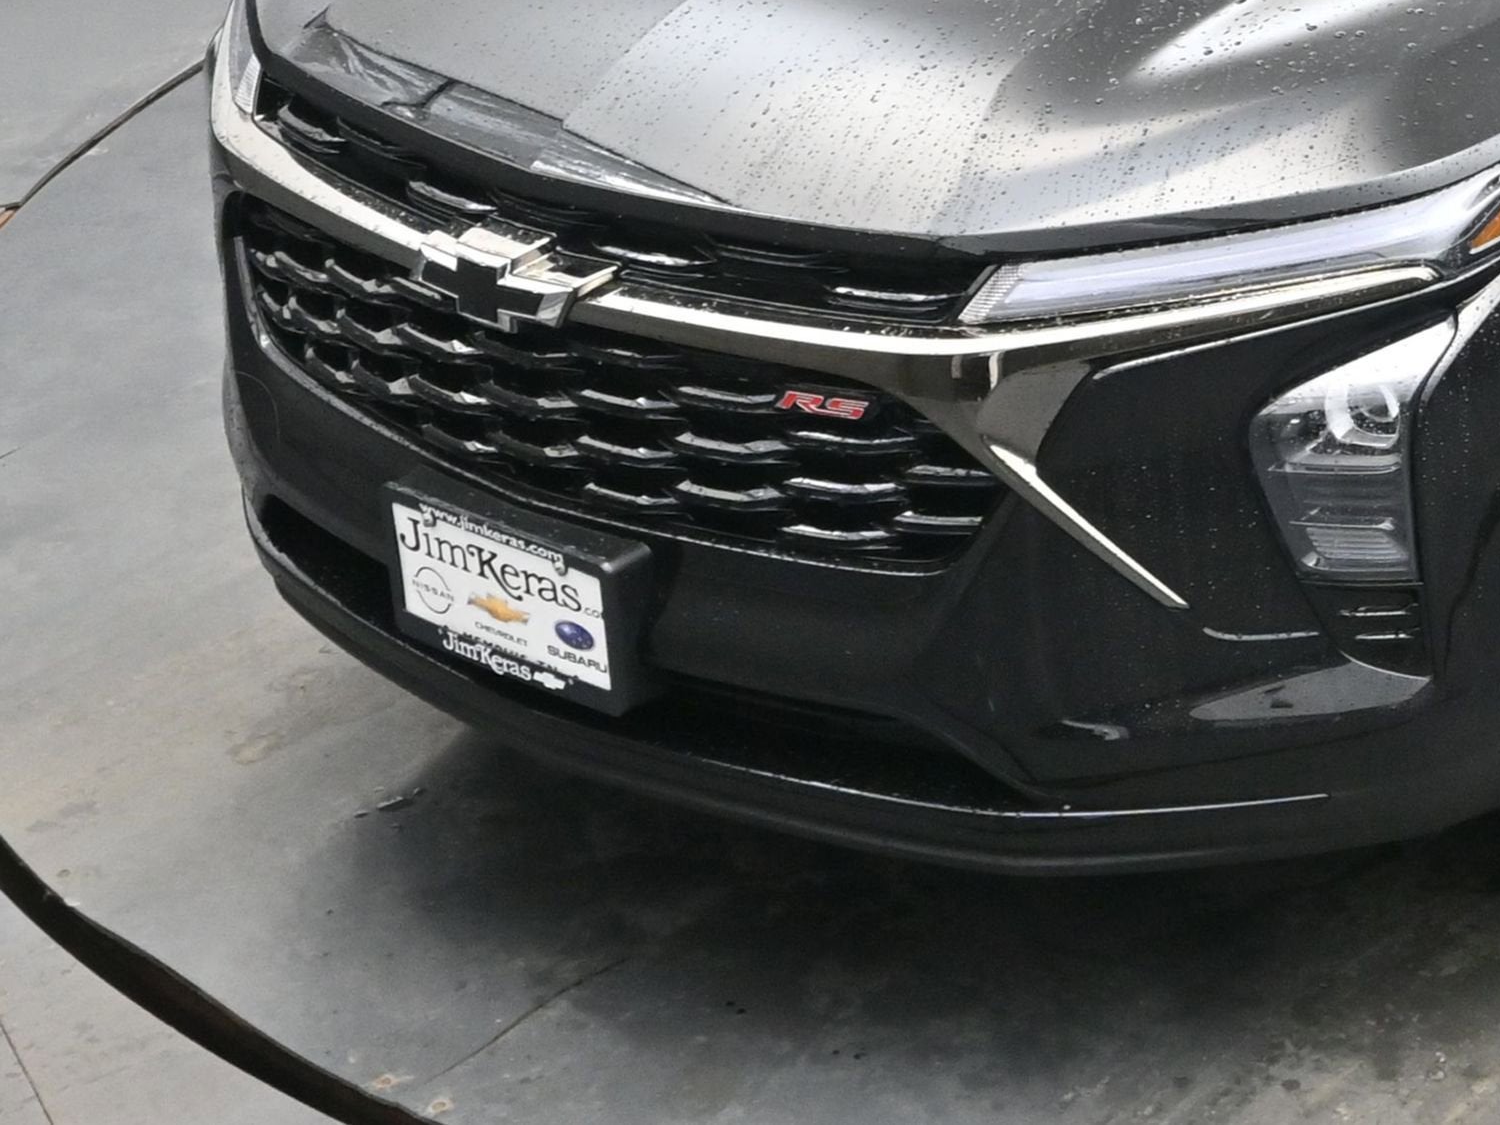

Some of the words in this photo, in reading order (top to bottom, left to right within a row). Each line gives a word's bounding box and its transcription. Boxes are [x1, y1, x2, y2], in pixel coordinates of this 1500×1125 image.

[774, 390, 869, 420] RS
[419, 503, 564, 563] www.jimkeras.com
[412, 578, 455, 602] NISSAN
[475, 621, 528, 647] CHEVROLET
[547, 644, 608, 673] SUBARU
